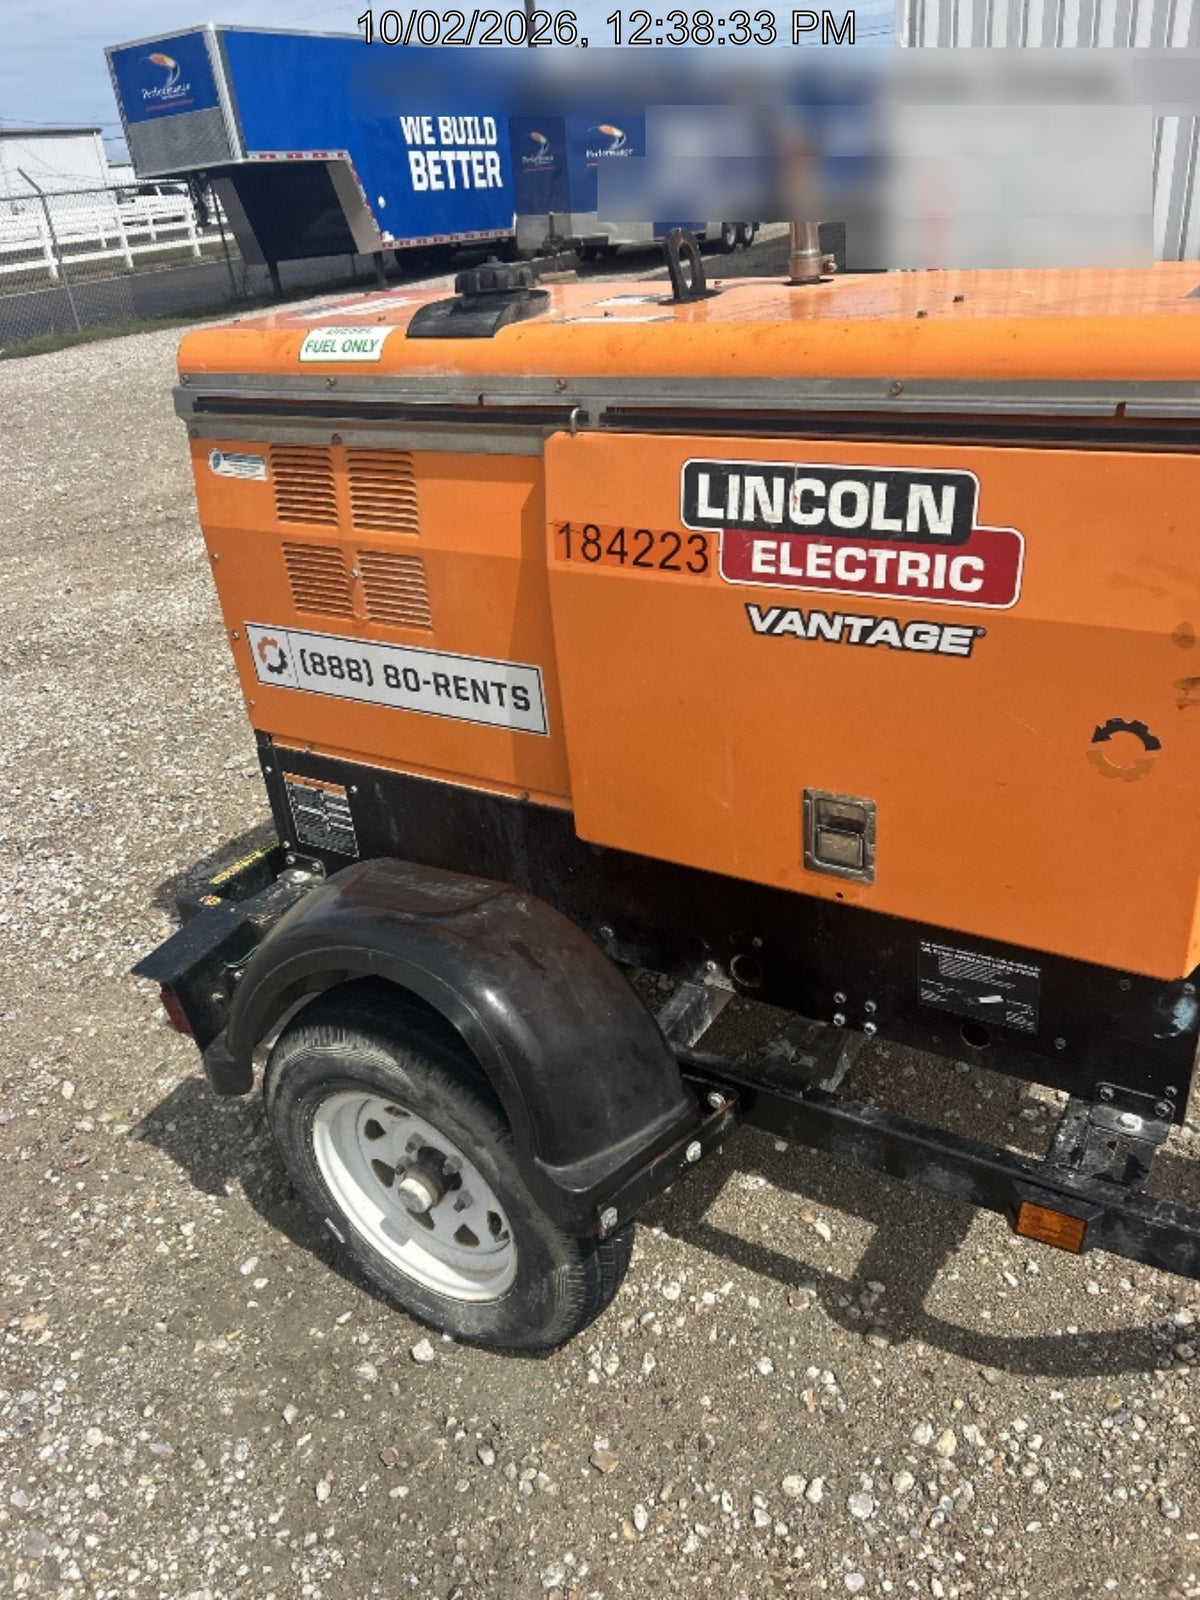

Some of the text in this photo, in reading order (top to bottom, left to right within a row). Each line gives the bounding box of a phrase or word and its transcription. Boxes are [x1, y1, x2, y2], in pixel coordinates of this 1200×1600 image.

[400, 116, 497, 145] WE BUILD
[408, 150, 504, 191] BETTER
[305, 339, 379, 353] FUEL ONLY
[697, 472, 957, 535] LINCOLN
[556, 522, 710, 573] 184223
[751, 540, 986, 593] ELECTRIC
[746, 603, 978, 657] VANTAGE
[299, 648, 531, 712] (888) 80-RENTS
